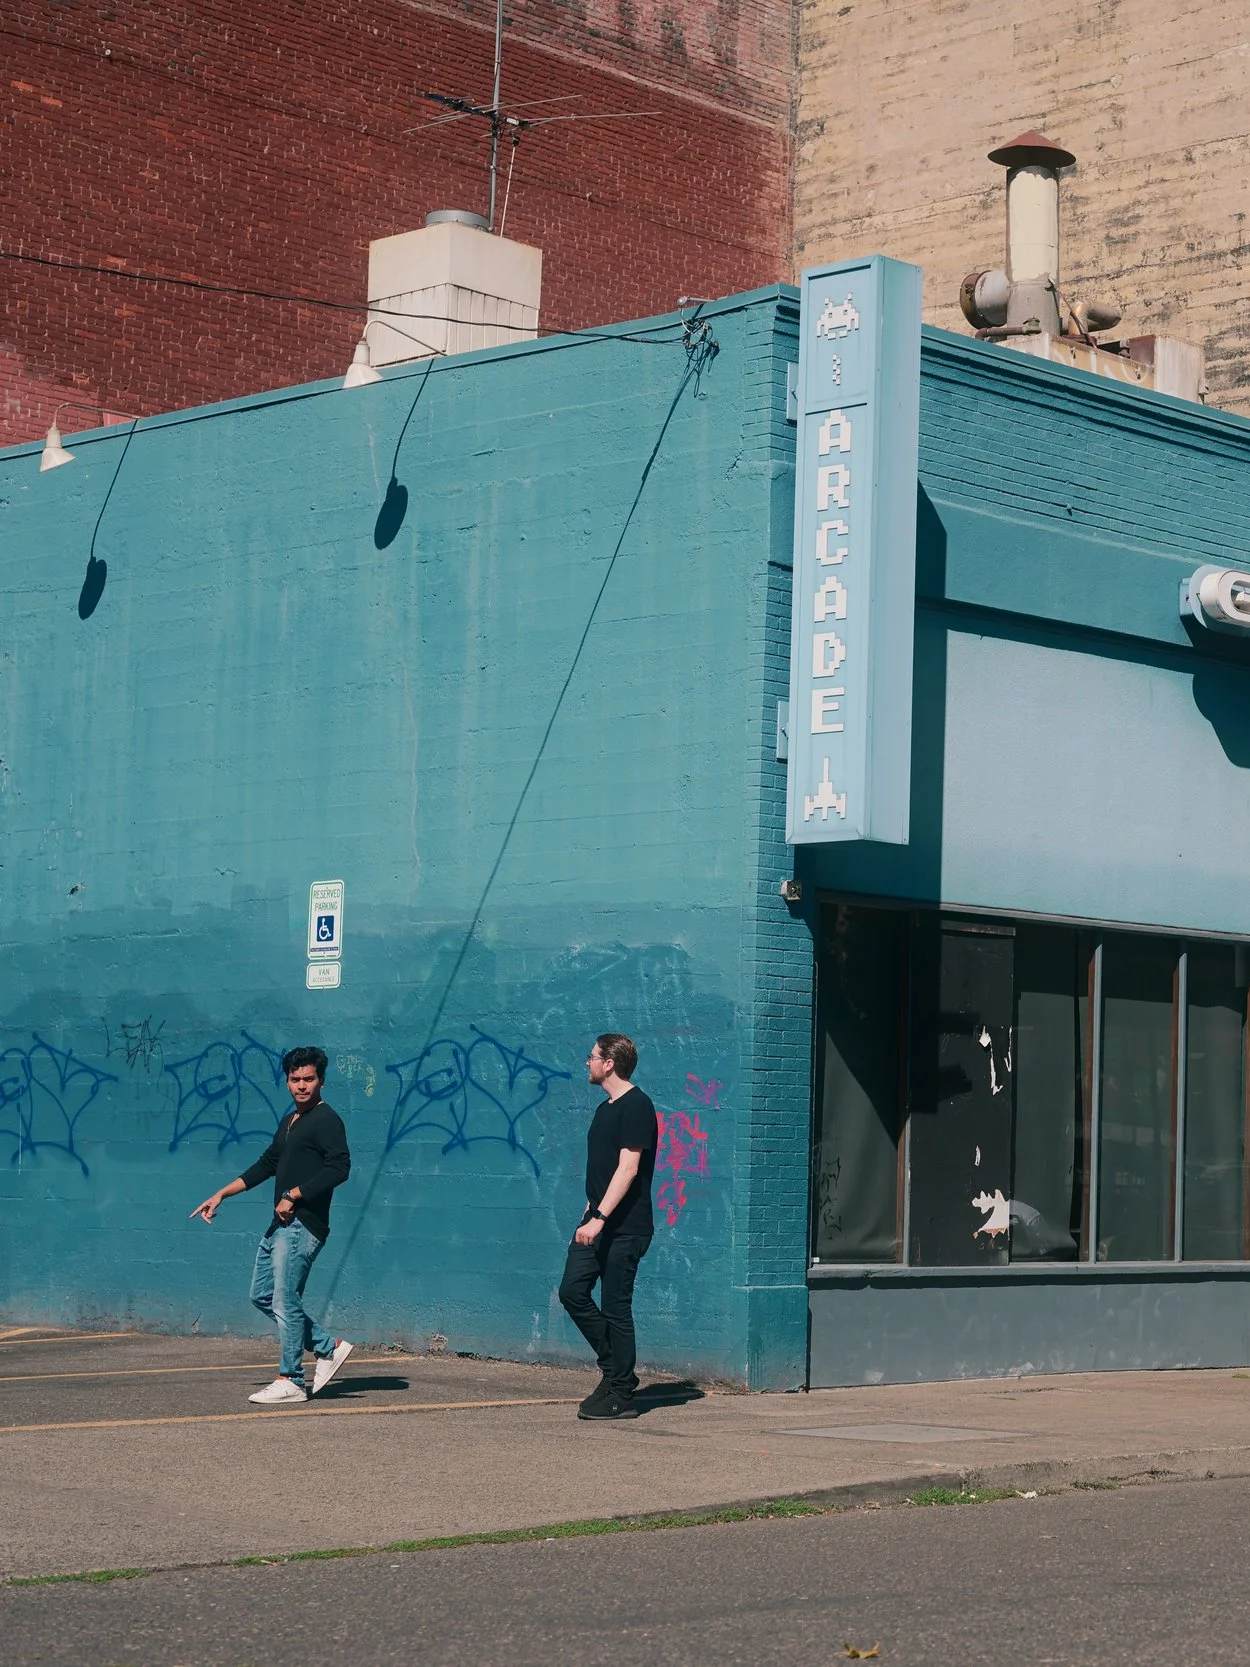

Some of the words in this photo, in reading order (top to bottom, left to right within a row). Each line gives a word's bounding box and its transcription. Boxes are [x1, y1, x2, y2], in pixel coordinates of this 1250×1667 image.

[811, 409, 852, 734] ARCADE
[313, 888, 340, 899] RESERVED
[314, 901, 338, 911] PARKING
[318, 968, 330, 976] VAN
